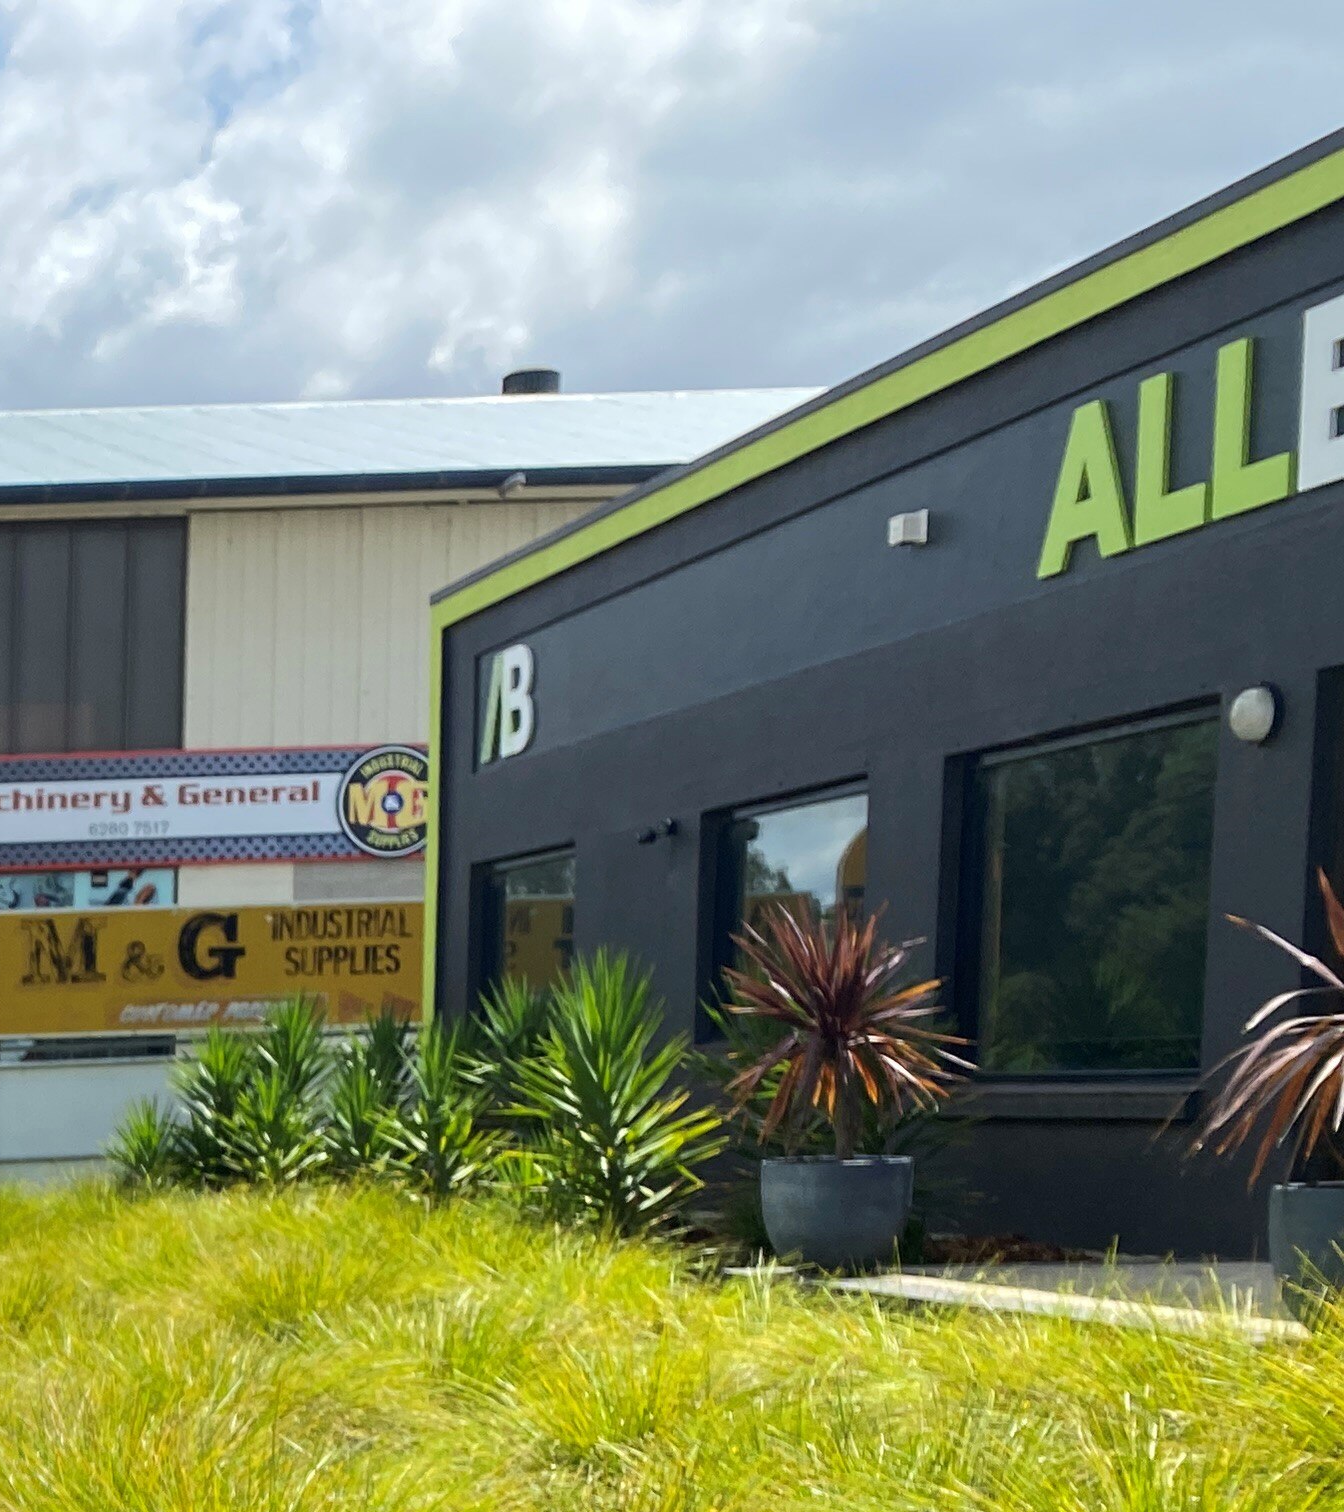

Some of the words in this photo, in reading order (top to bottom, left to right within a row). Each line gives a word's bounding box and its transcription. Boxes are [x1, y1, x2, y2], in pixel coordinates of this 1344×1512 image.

[141, 784, 167, 807] &
[177, 780, 320, 806] General
[271, 908, 413, 941] INDUSTRIAL
[20, 916, 108, 985] M
[120, 940, 166, 983] &
[177, 912, 246, 981] G
[284, 944, 401, 977] SUPPLIES
